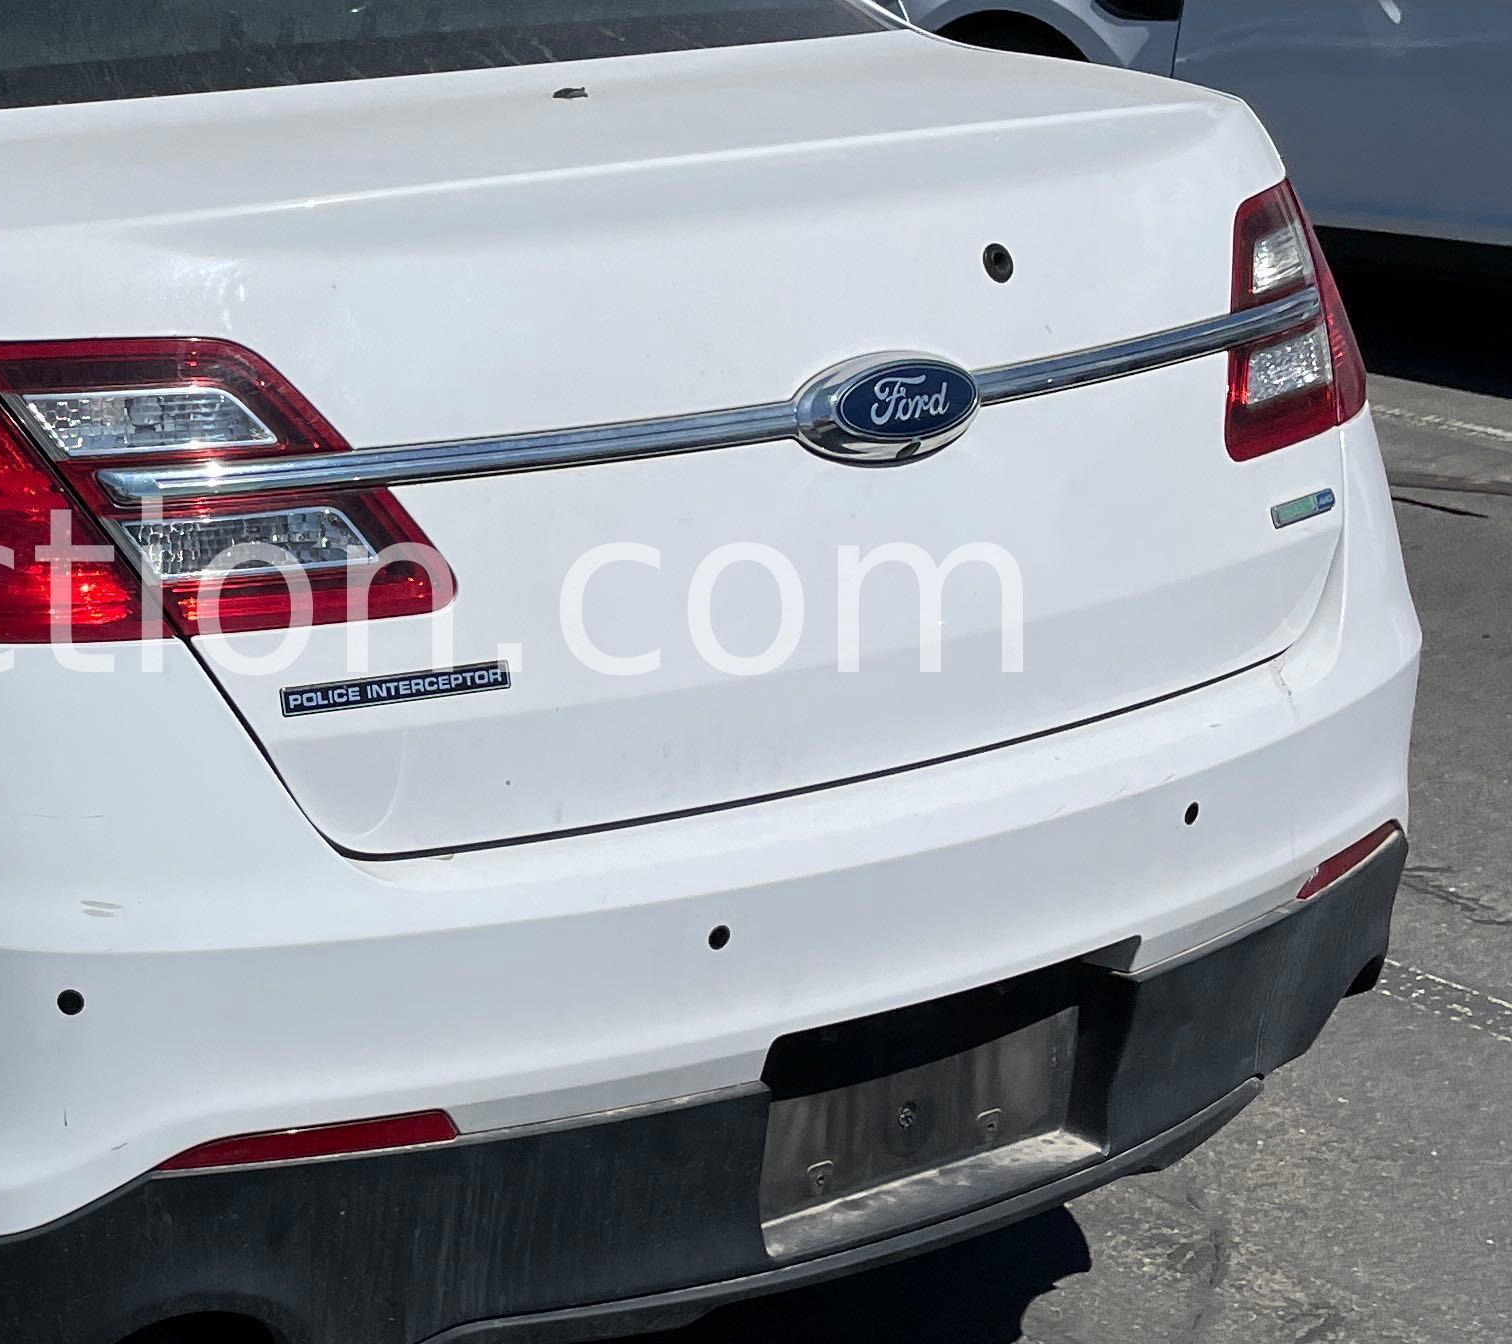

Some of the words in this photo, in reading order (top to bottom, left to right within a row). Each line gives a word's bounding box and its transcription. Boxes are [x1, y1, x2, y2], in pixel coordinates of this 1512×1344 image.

[870, 375, 950, 426] Ford
[288, 687, 361, 709] POLICE
[366, 668, 503, 700] INTERCEPTOR
